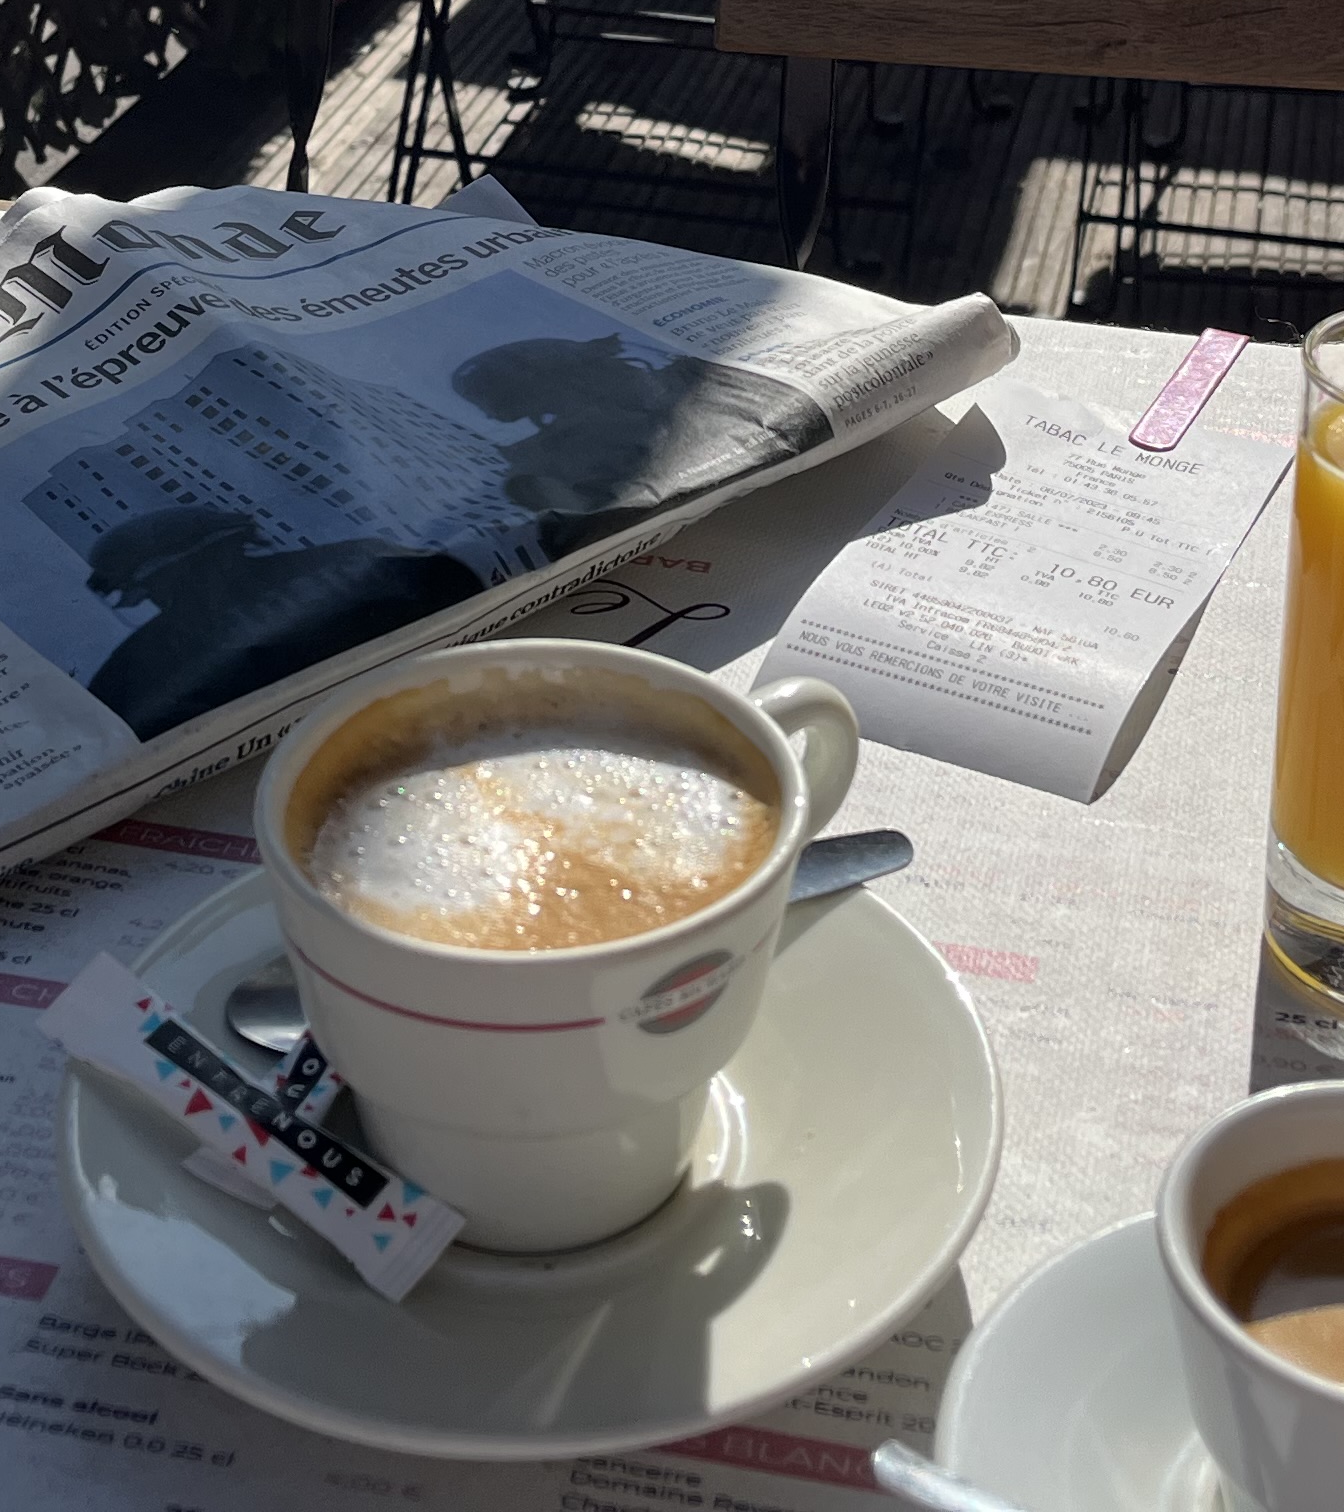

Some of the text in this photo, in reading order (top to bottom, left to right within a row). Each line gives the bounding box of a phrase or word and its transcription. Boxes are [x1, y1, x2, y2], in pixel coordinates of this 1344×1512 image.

[3, 389, 45, 420] à
[40, 292, 228, 401] l'épreuve
[301, 251, 468, 319] émeutes
[85, 298, 152, 351] ÉDITION
[818, 370, 845, 389] sur
[860, 332, 922, 371] jeunesse
[832, 354, 925, 412] postcoloniale
[844, 405, 873, 428] PAGES
[1024, 414, 1205, 477] TABAC LE MONGE
[1075, 470, 1117, 488] France
[510, 531, 662, 623] contradictoire
[886, 514, 950, 544] TOTAL
[1129, 586, 1177, 610] EUR
[798, 630, 1062, 714] NOUS VOUS REMERCIONS DE VOTRE VISITE
[926, 639, 975, 661] Caisse
[1275, 1011, 1306, 1024] 25
[270, 1111, 365, 1187] NOUS
